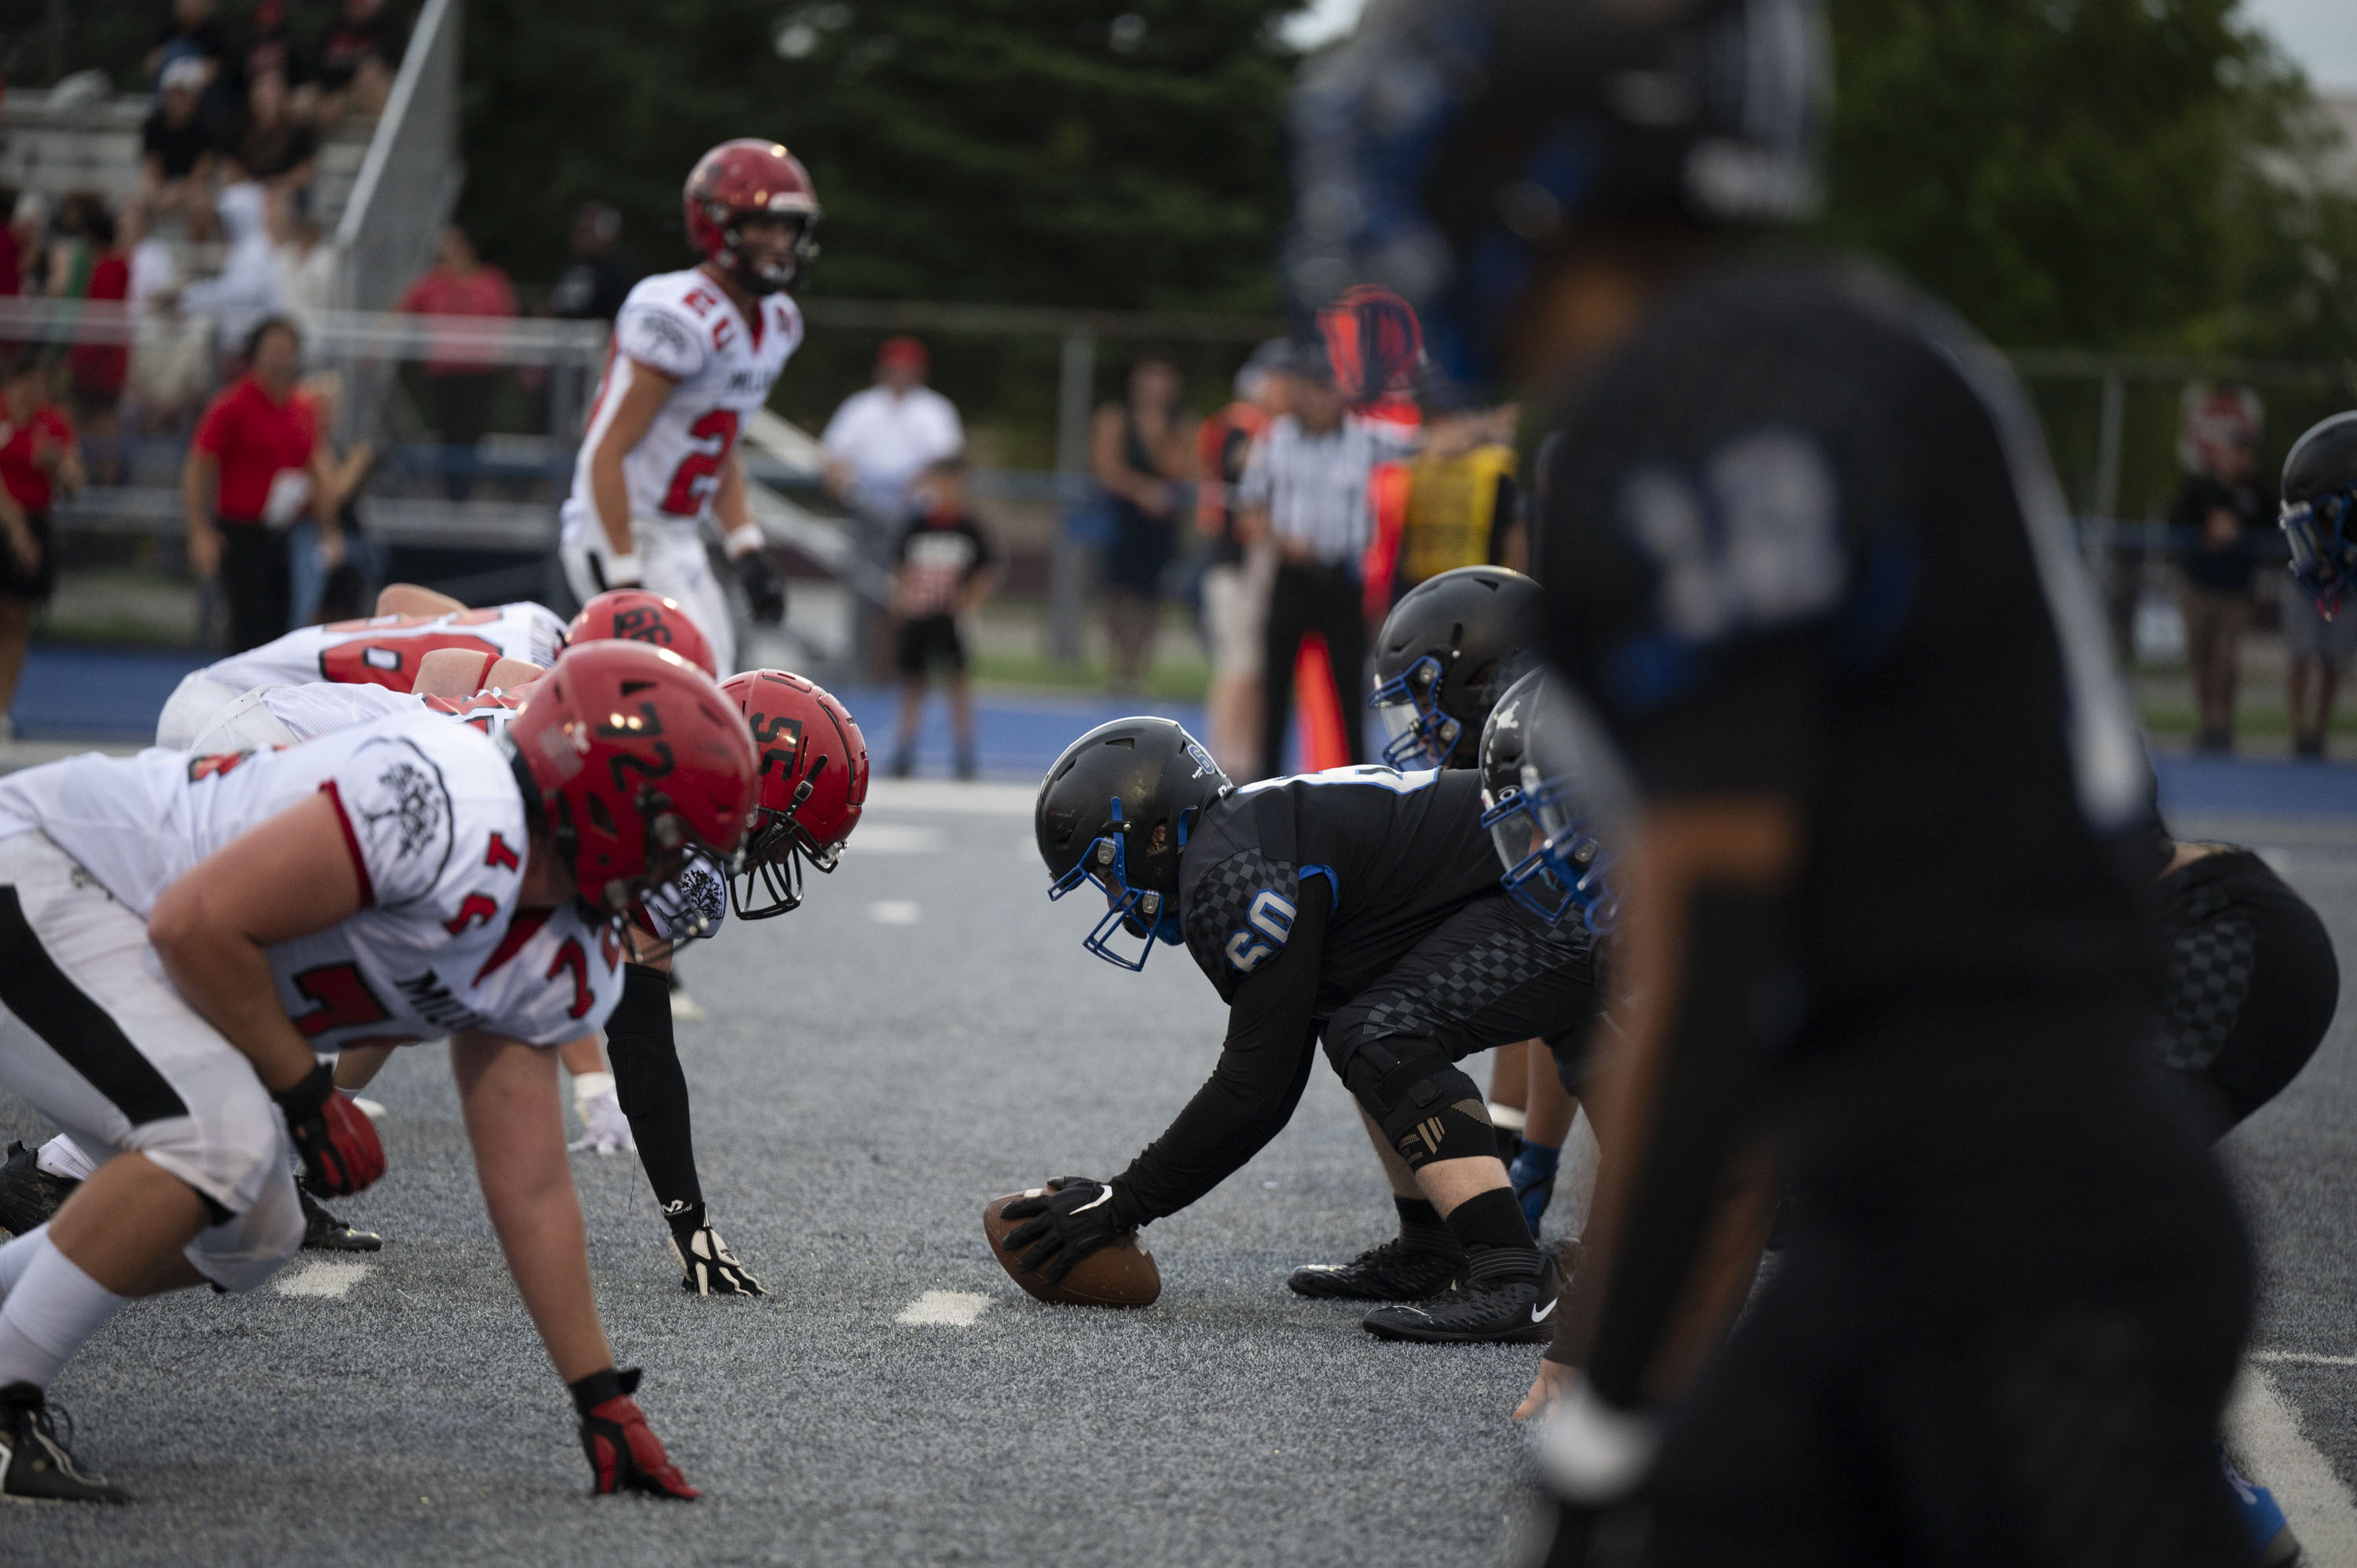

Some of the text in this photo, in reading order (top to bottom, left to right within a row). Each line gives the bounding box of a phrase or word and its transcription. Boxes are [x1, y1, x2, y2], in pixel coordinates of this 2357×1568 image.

[595, 700, 674, 791] 72
[1186, 743, 1215, 775] 6
[1225, 888, 1298, 973] 60
